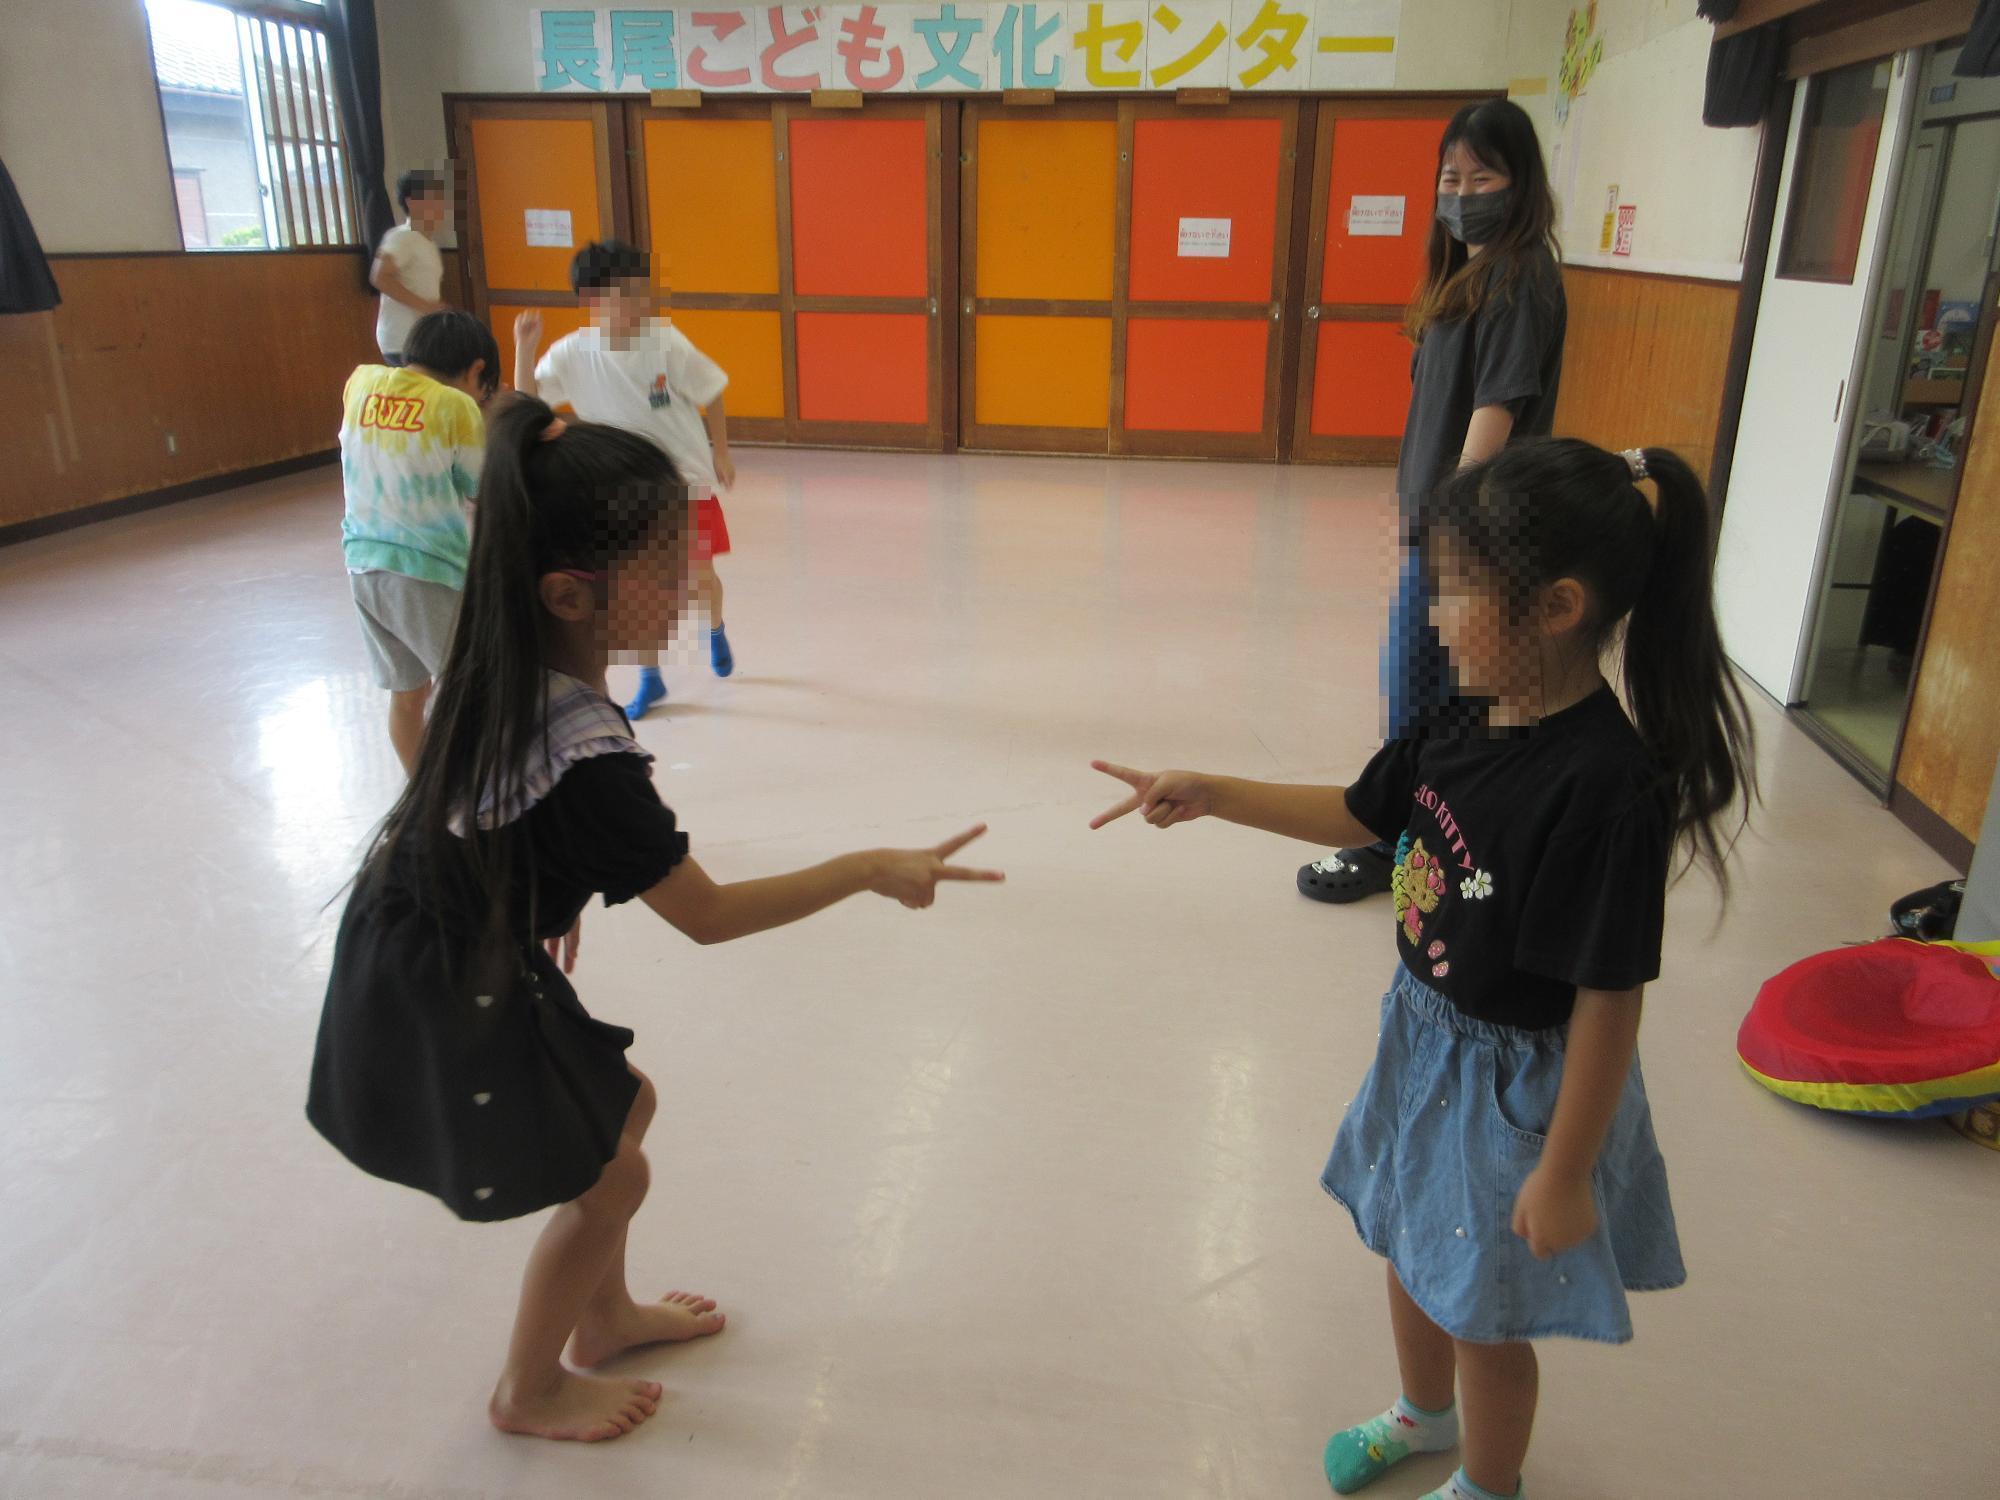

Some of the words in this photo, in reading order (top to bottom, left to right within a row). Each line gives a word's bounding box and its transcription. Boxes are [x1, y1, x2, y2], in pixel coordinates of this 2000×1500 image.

[539, 0, 1395, 92] 長尾こども文化センター
[361, 394, 424, 431] BUZZ
[1435, 801, 1475, 871] KITTY
